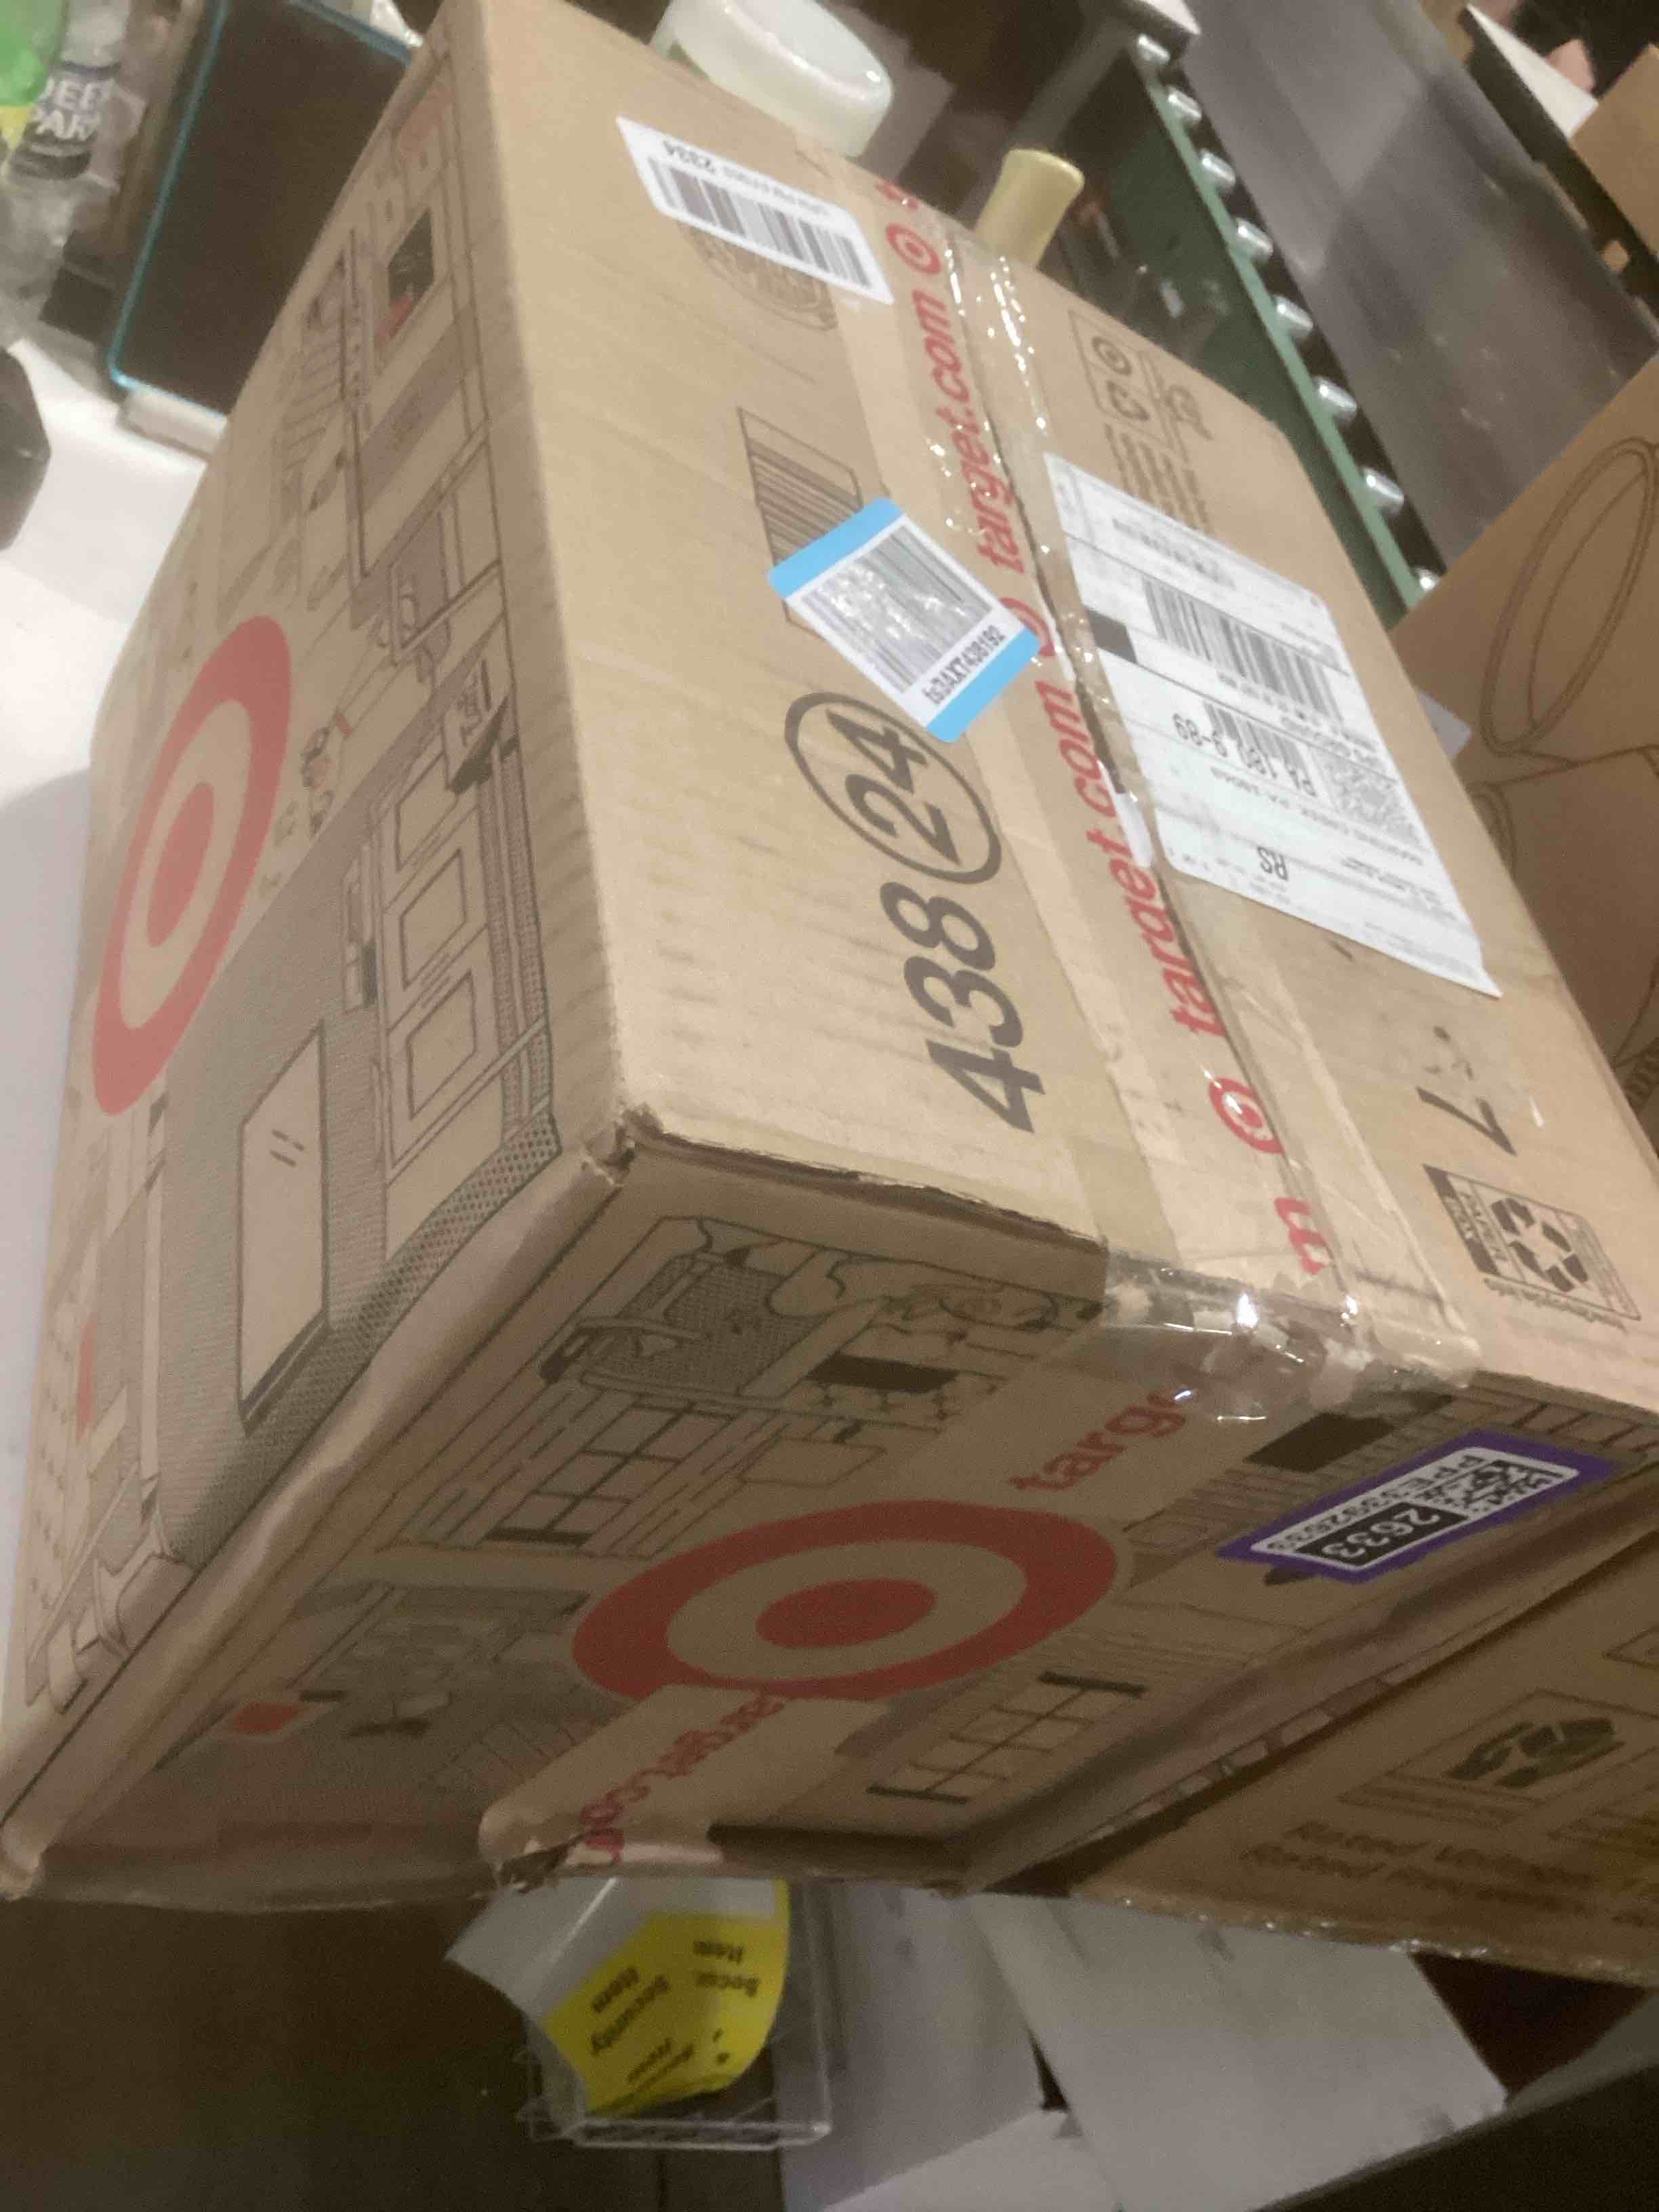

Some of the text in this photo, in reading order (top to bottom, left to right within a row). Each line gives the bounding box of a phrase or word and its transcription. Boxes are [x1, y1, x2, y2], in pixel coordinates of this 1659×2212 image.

[912, 289, 1025, 573] target.com
[825, 709, 1046, 1134] 438 24
[1256, 845, 1289, 882] RS
[1320, 1507, 1441, 1559] 2633
